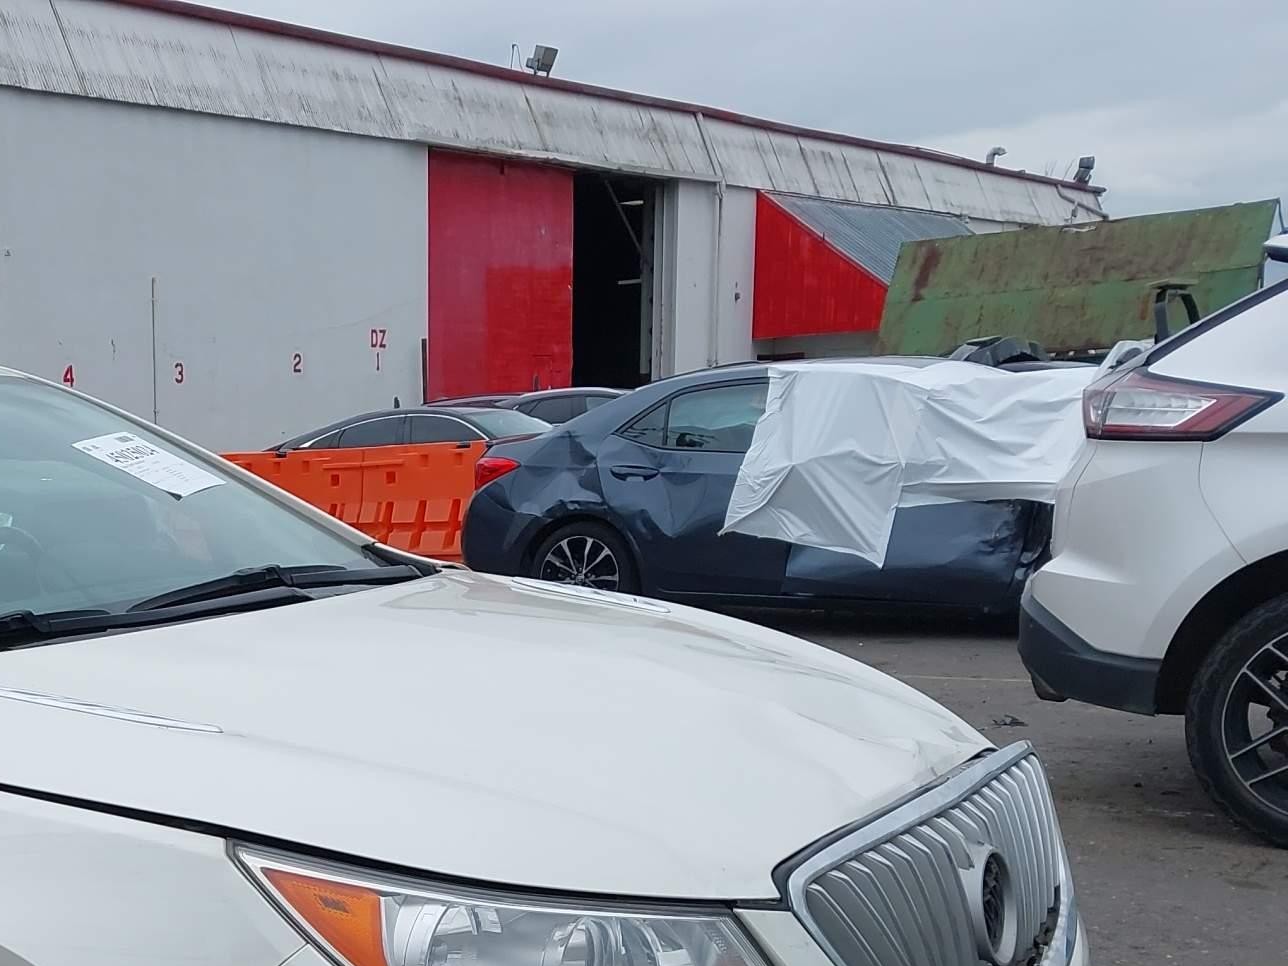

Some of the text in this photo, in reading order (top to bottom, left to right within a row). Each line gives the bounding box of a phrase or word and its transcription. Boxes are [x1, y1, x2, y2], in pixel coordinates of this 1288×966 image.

[370, 329, 387, 348] DZ
[174, 362, 184, 384] 3
[293, 353, 302, 373] 2
[63, 364, 75, 388] 4
